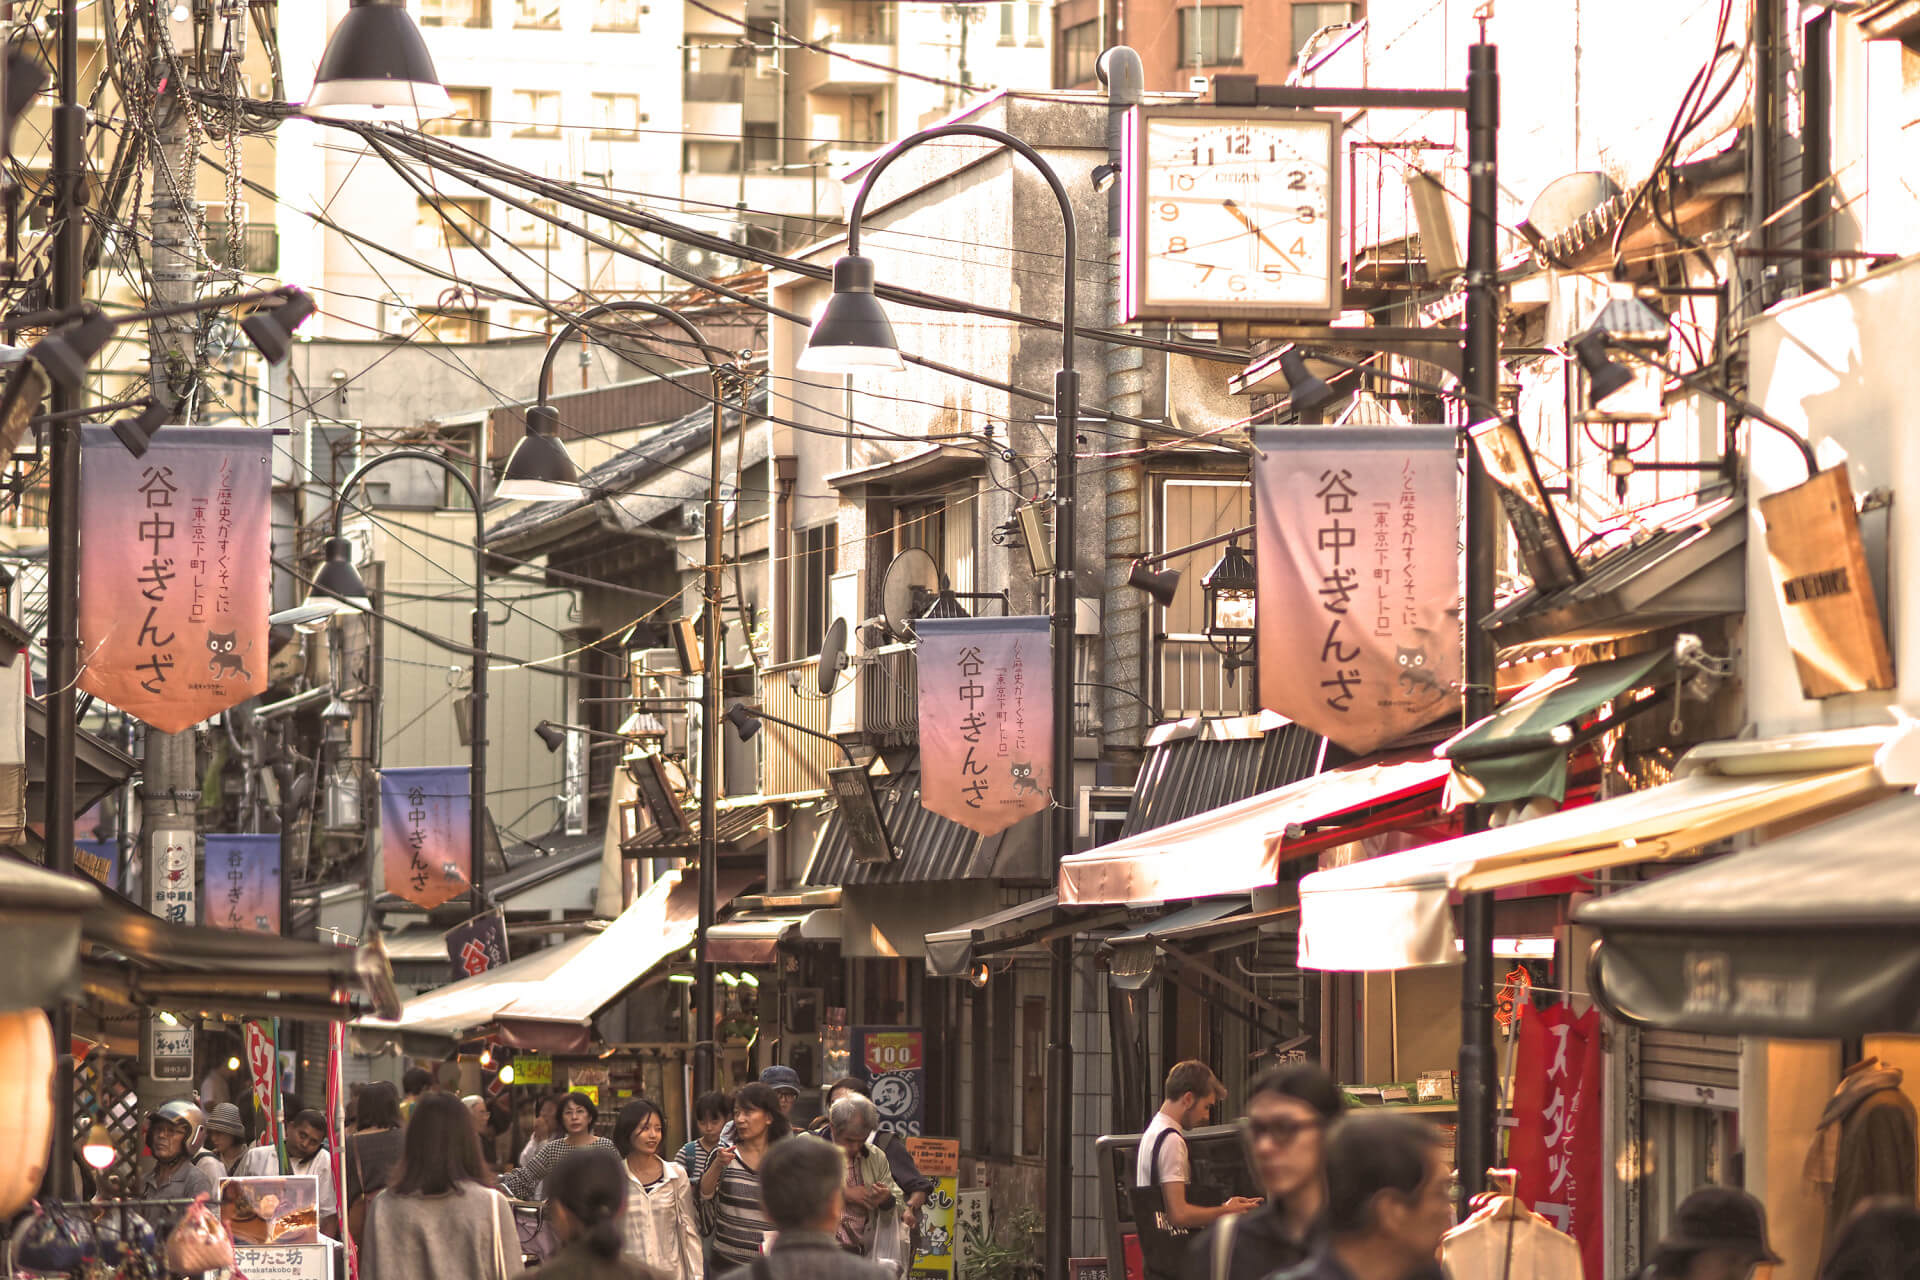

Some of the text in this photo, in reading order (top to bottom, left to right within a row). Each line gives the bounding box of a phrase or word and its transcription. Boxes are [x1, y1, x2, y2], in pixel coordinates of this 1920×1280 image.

[1226, 134, 1251, 154] 12
[1268, 144, 1275, 162] 1
[1192, 146, 1214, 166] 11
[1169, 173, 1195, 191] 10
[1287, 170, 1306, 190] 2
[1159, 202, 1179, 222] 9
[1296, 205, 1316, 224] 3
[1168, 235, 1188, 254] 8
[1289, 236, 1307, 257] 4
[1195, 263, 1215, 283] 7
[1227, 274, 1247, 292] 6
[1263, 264, 1282, 282] 5
[136, 466, 178, 694] 谷中ぎんざ
[1315, 469, 1362, 712] 谷中ぎんざ
[957, 647, 989, 808] 谷中ぎんざ
[408, 786, 429, 892] 谷中ぎんざ
[227, 850, 243, 931] 谷中ぎん
[872, 1047, 910, 1064] 100
